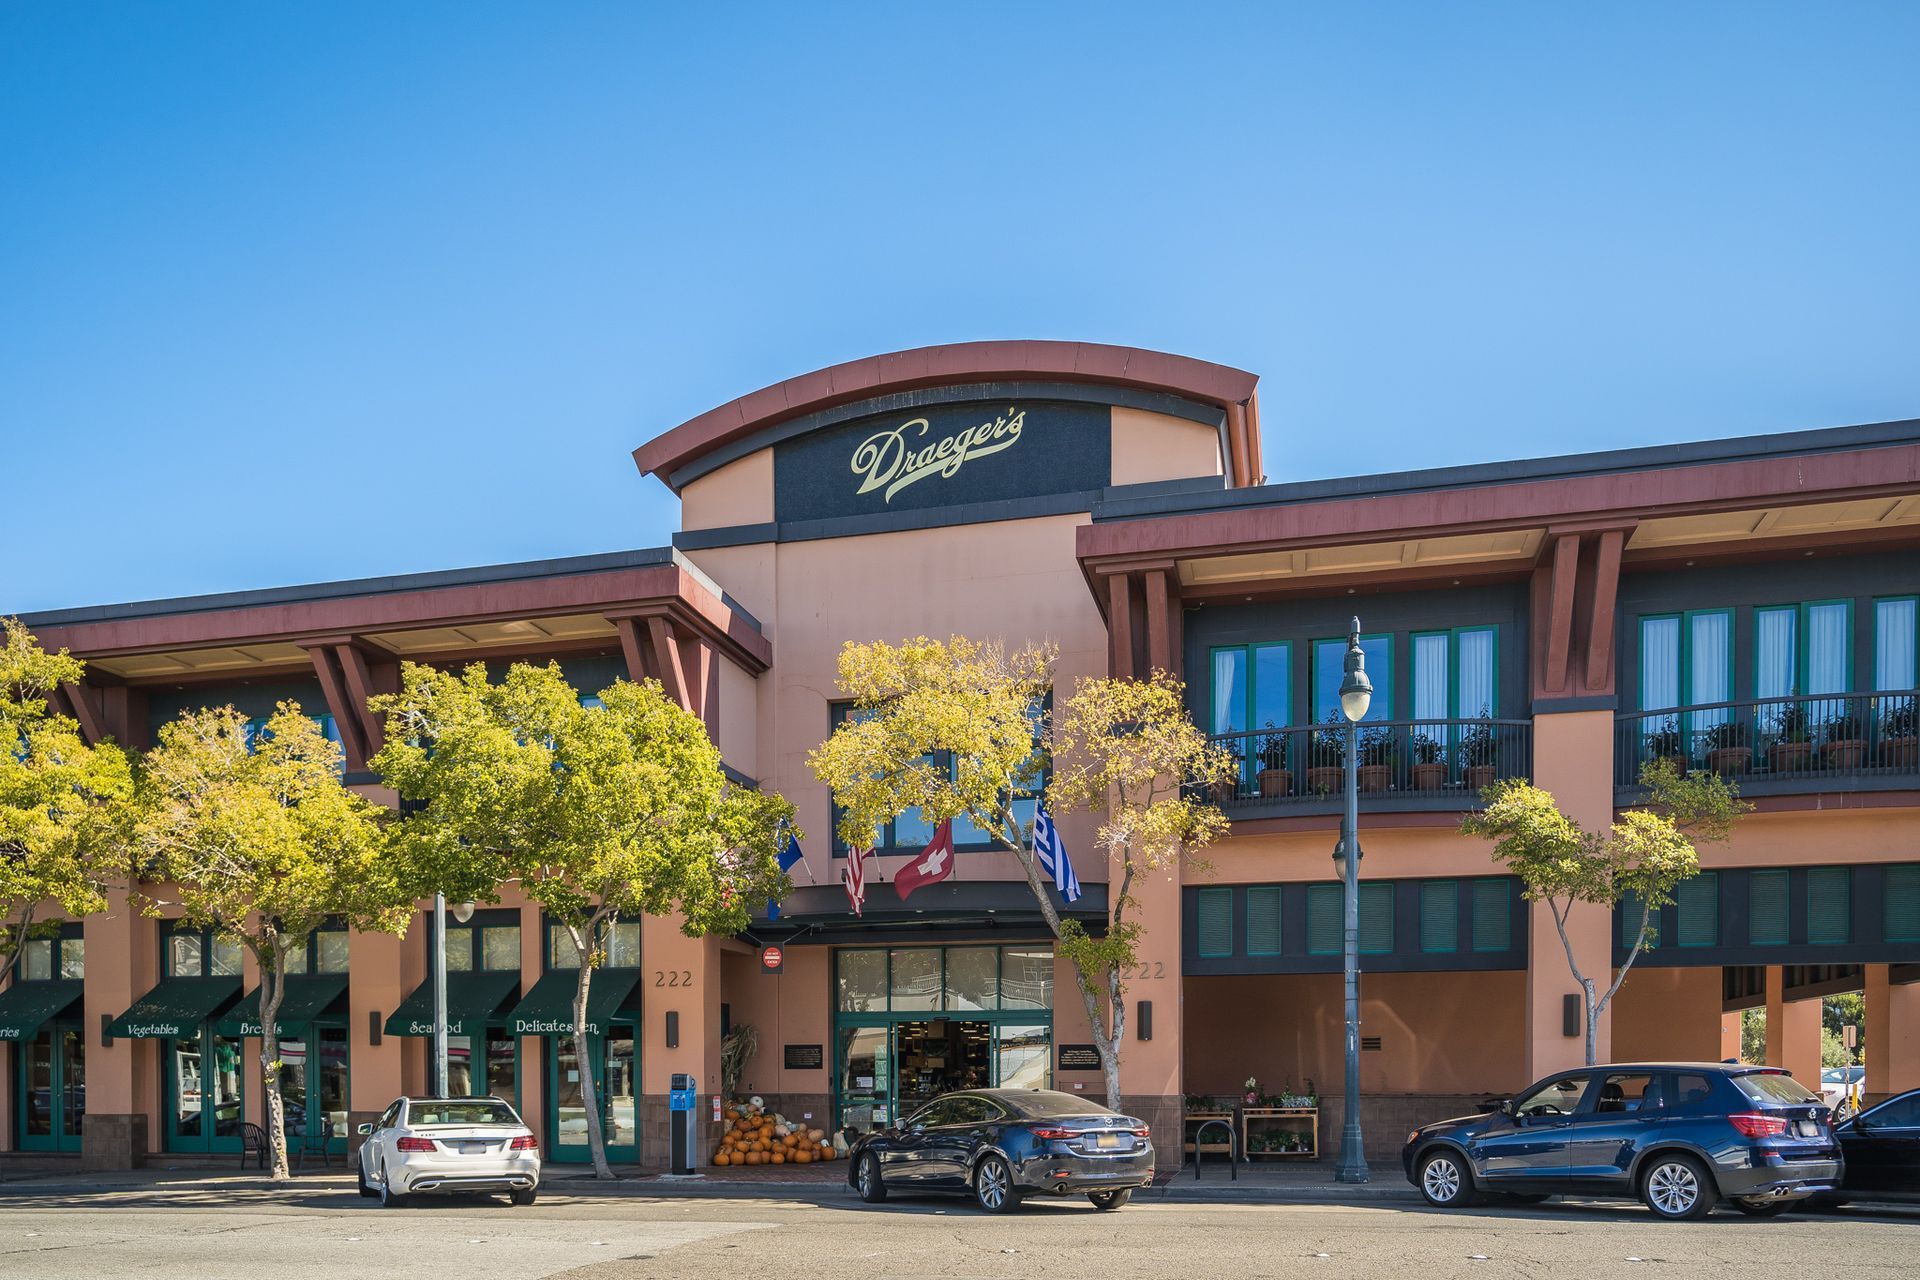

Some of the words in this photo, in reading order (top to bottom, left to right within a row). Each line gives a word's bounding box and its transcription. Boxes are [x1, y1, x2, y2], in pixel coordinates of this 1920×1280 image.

[850, 407, 1026, 504] Draeger's
[655, 970, 693, 988] 222
[127, 1024, 179, 1038] Vegetables
[409, 1020, 462, 1034] Seaod
[516, 1020, 600, 1035] Delicatesen
